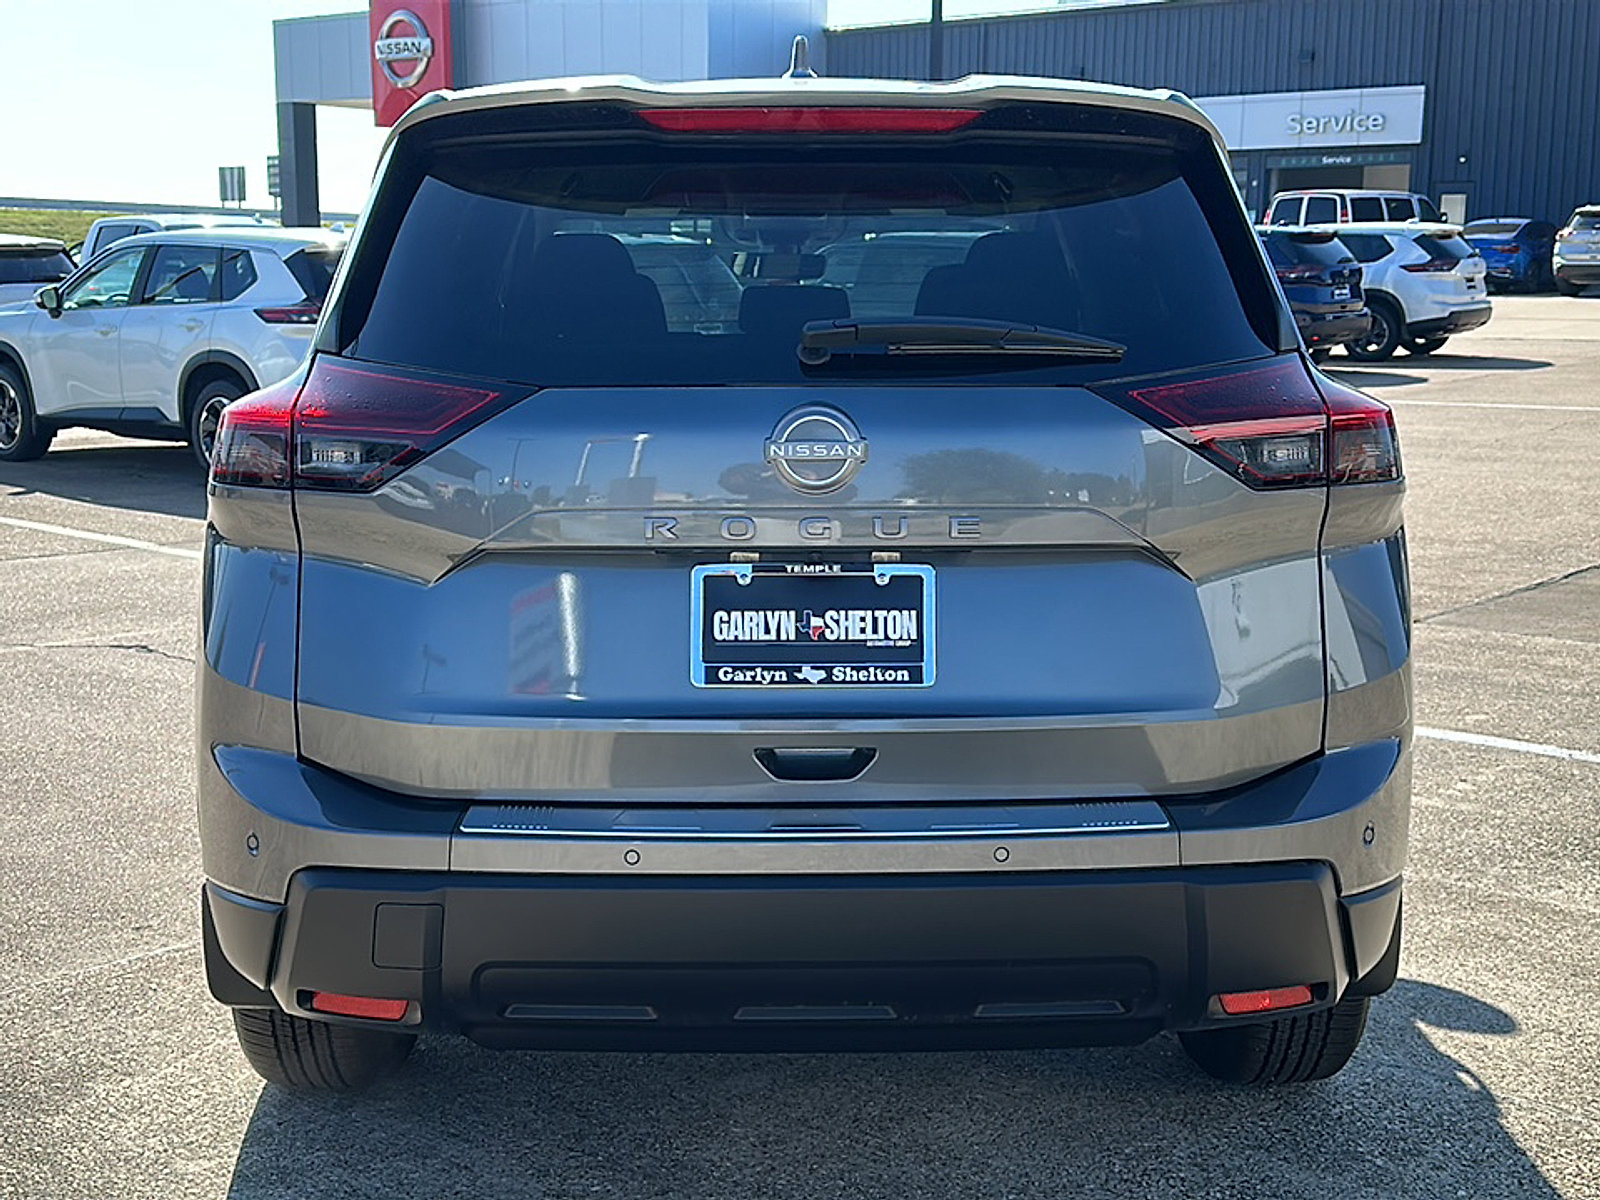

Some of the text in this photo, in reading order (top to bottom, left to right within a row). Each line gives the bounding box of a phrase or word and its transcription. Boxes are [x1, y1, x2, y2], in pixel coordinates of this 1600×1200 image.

[376, 41, 422, 55] NISSAN
[1286, 109, 1385, 135] Service
[1321, 155, 1352, 165] Service
[769, 443, 863, 457] NISSAN
[643, 516, 982, 541] ROGUE
[784, 564, 842, 574] TEMPLE
[712, 609, 918, 642] GARLYN SHELTON
[717, 666, 910, 686] Garlyn Shelton
